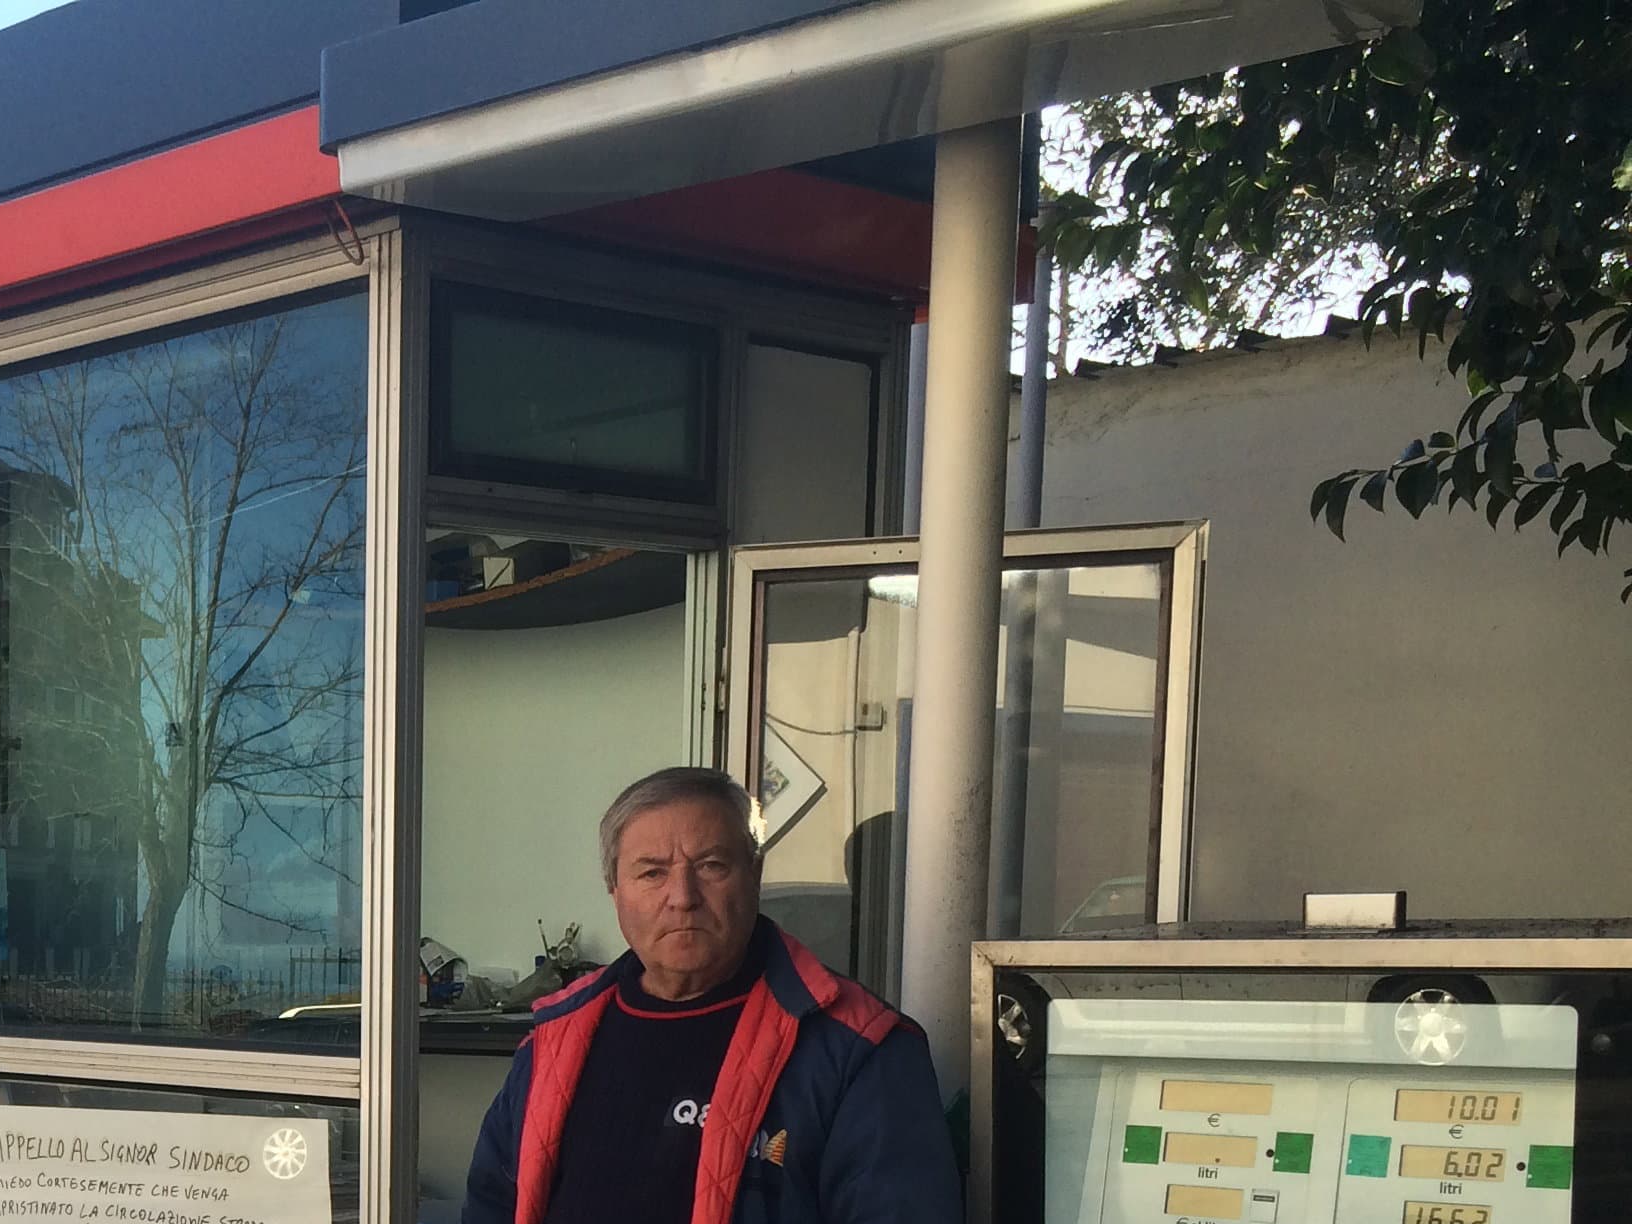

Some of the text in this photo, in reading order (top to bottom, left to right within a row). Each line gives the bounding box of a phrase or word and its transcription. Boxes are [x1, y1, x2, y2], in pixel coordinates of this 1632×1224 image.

[1208, 1113, 1221, 1127] €
[1449, 1124, 1464, 1139] €
[70, 1137, 96, 1162] AL
[100, 1140, 158, 1166] SIGNOR
[169, 1146, 250, 1173] SINDACO
[1443, 1151, 1503, 1177] 6.02
[1198, 1167, 1218, 1179] litri
[37, 1172, 145, 1197] CORTESEMENTE
[151, 1184, 179, 1198] CHE
[184, 1184, 230, 1201] VENGA
[1439, 1182, 1462, 1195] litri
[79, 1203, 98, 1219] LA
